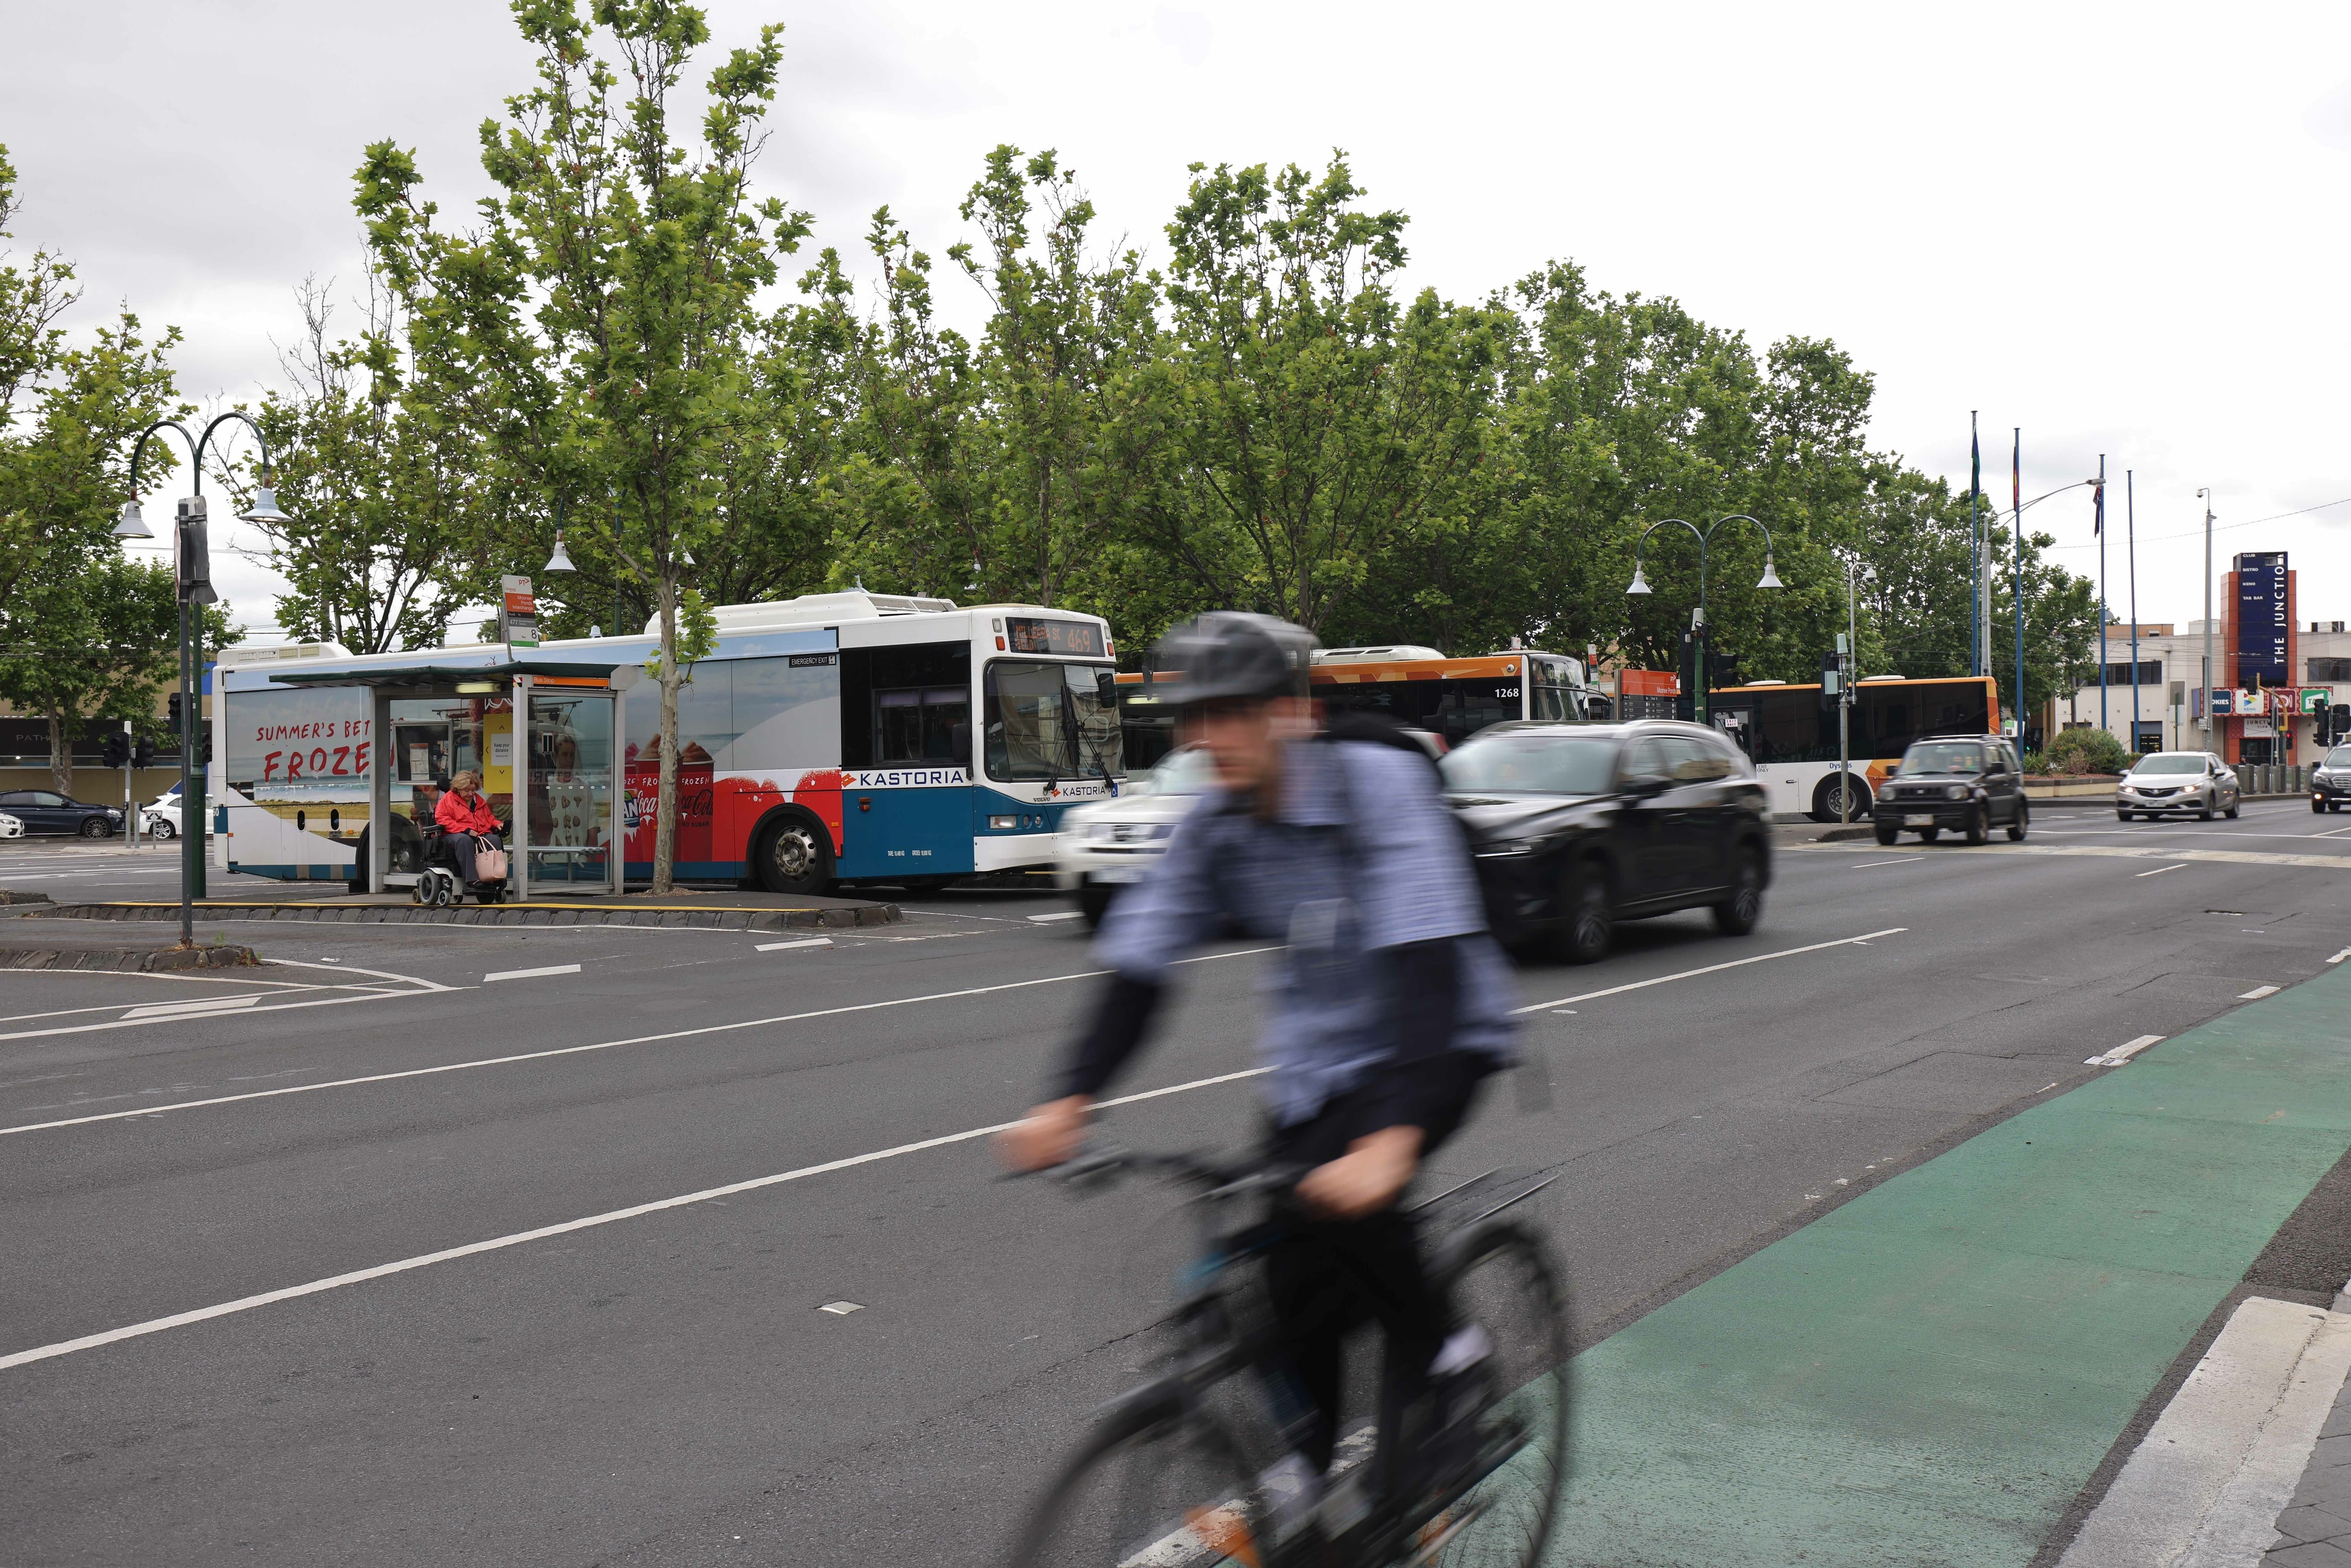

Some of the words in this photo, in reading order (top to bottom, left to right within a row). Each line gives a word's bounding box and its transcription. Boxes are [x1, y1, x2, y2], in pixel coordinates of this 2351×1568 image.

[531, 629, 537, 639] 8
[1068, 629, 1090, 652] 469
[2274, 637, 2284, 664] THE
[1494, 688, 1520, 698] 1268
[256, 722, 335, 741] SUMMER'S
[264, 741, 373, 784] FROZE
[681, 776, 710, 786] FROZEN
[860, 770, 964, 786] KASTORIA
[1063, 786, 1106, 797] KASTORIA
